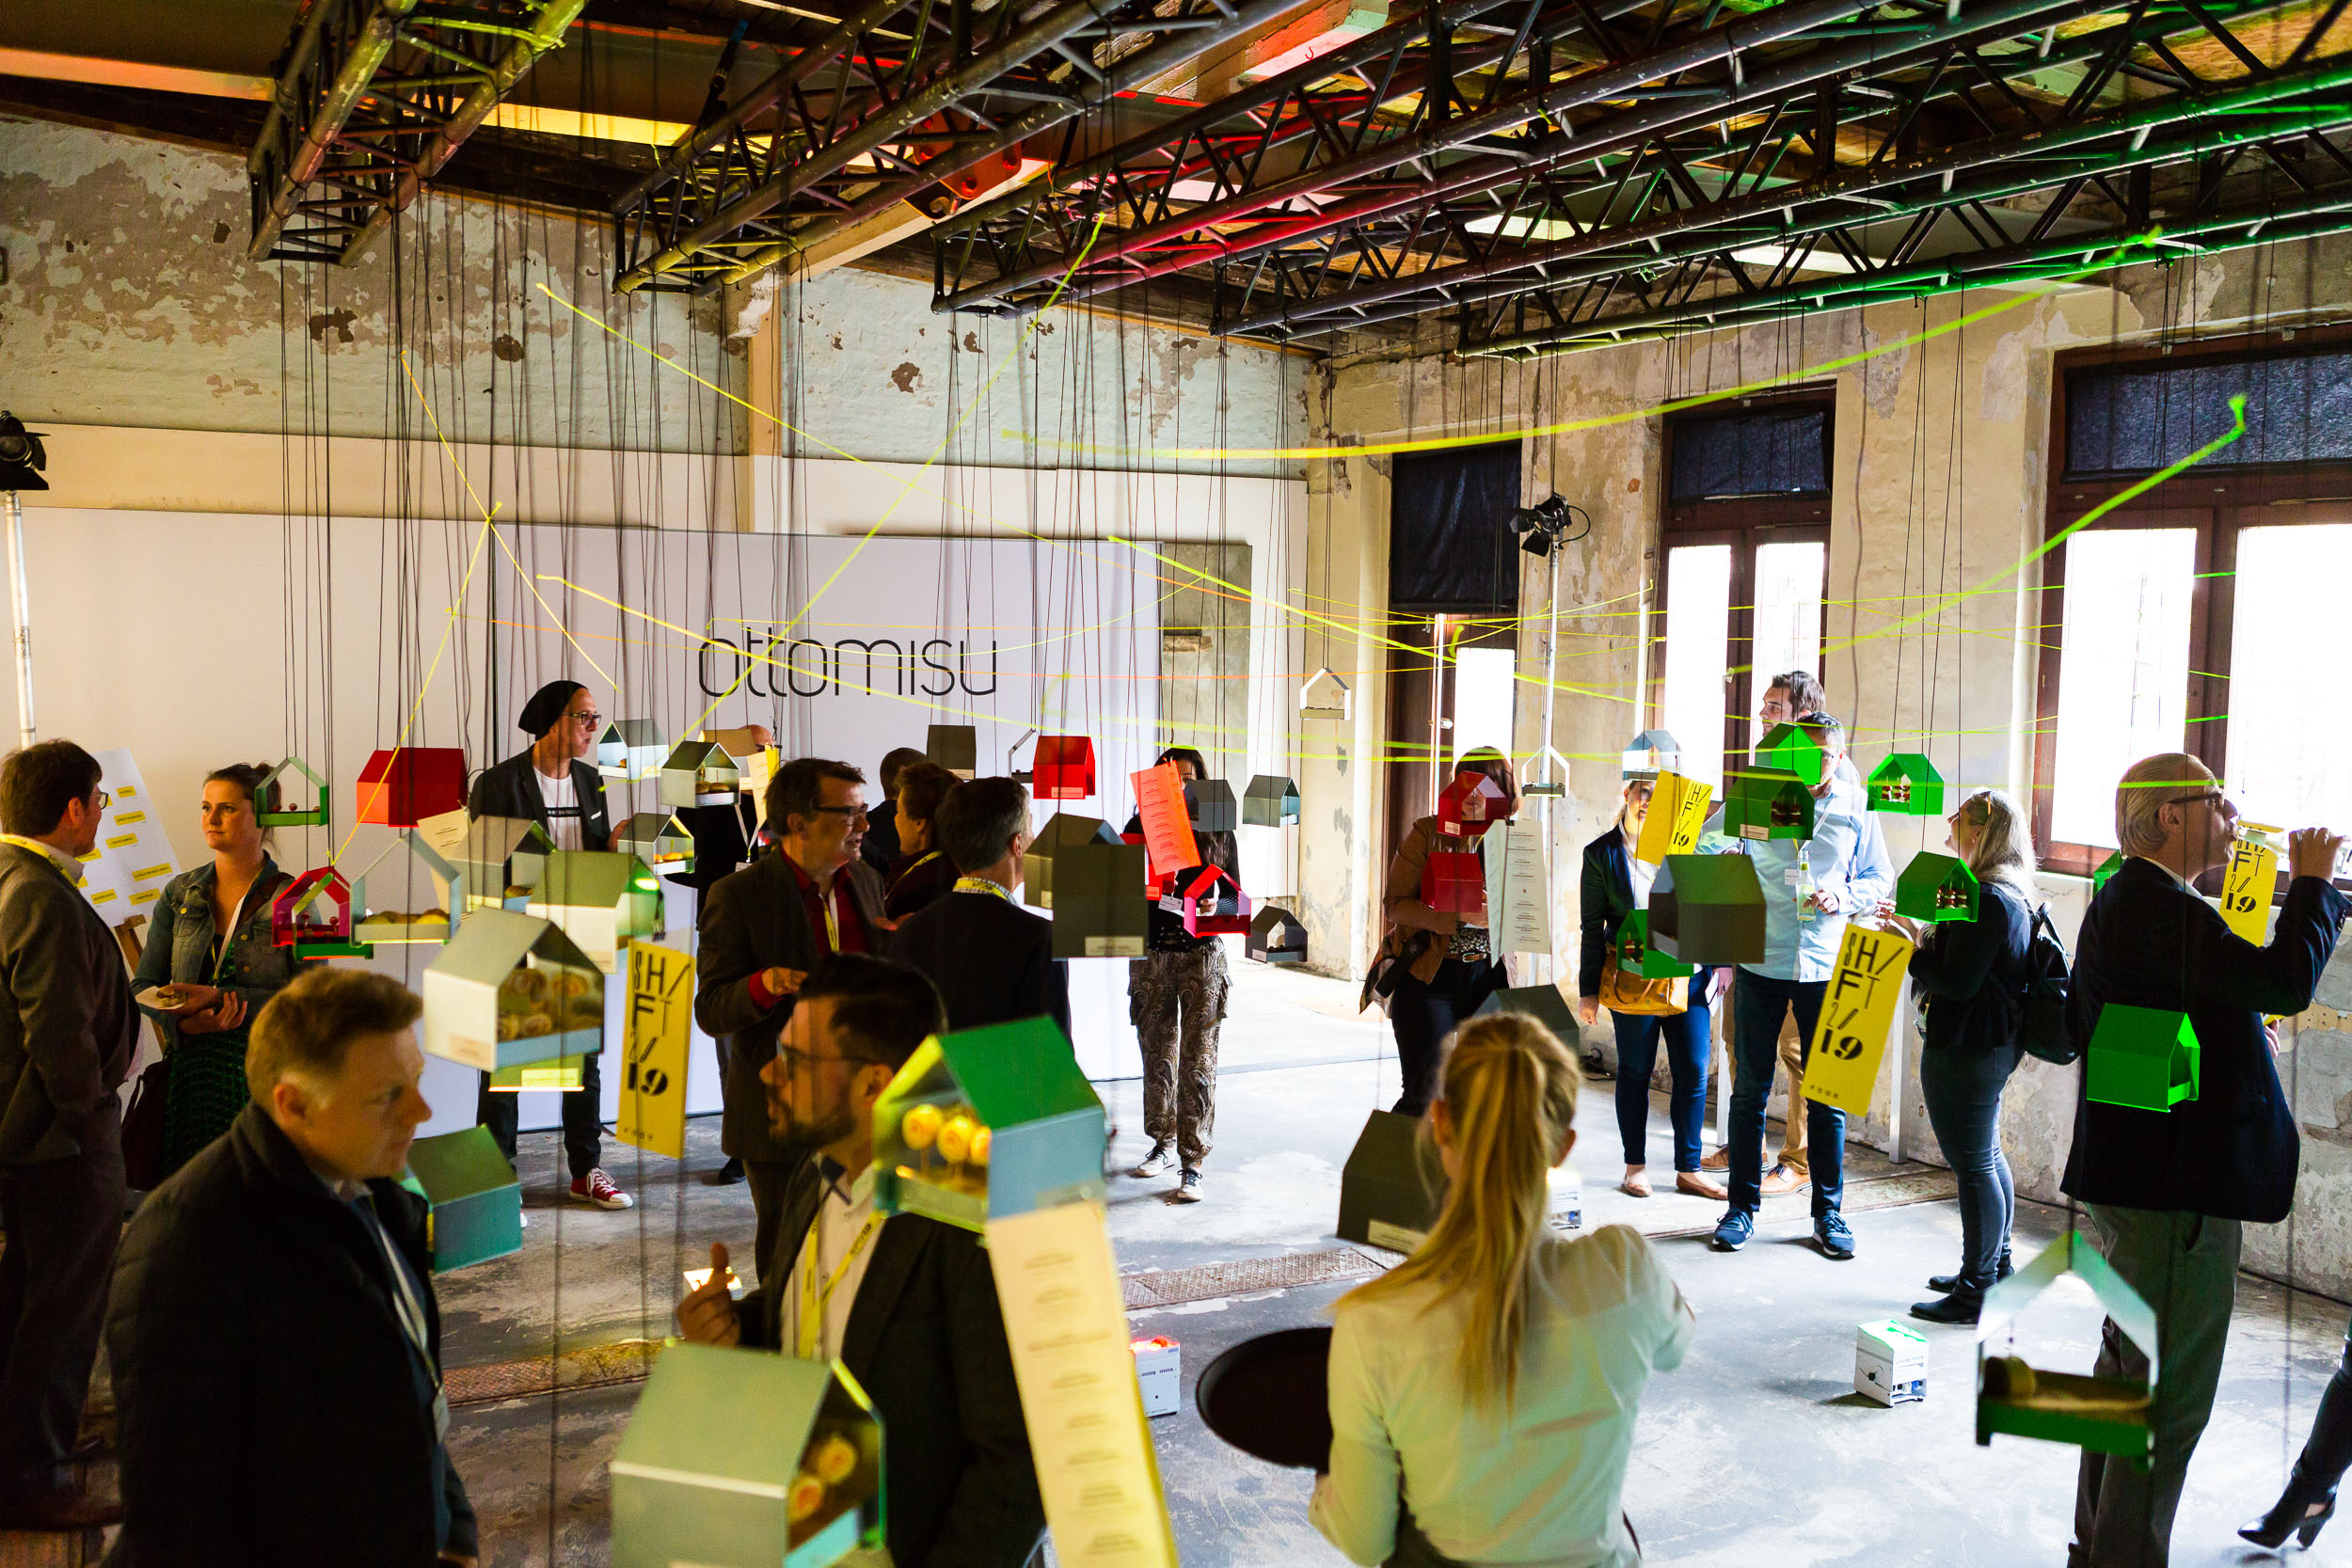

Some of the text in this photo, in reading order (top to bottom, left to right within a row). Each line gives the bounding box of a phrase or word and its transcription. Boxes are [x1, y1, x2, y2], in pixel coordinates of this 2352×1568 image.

[698, 626, 997, 698] ottomisu
[1673, 832, 1690, 847] 19
[2233, 849, 2265, 877] FT
[2226, 892, 2257, 913] 19
[1835, 968, 1881, 1009] FT
[631, 993, 673, 1037] FT
[1820, 1028, 1864, 1061] 19
[627, 1062, 668, 1096] 19
